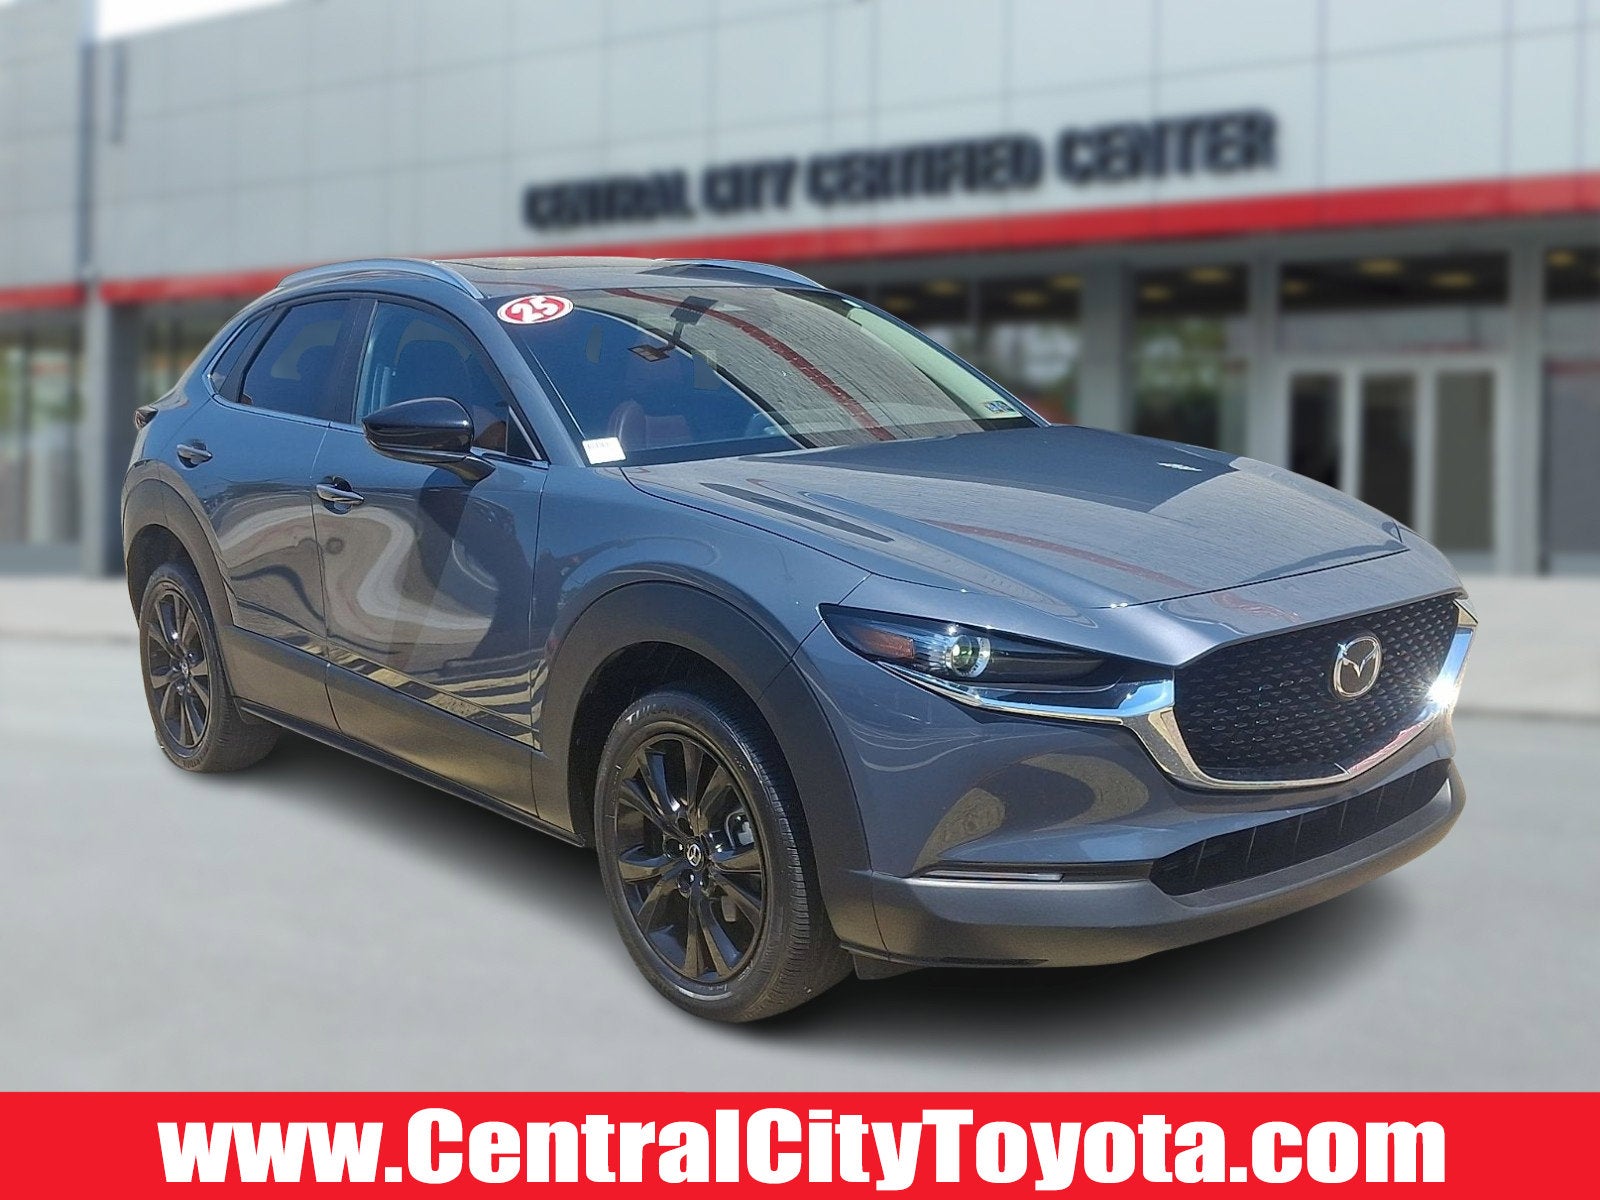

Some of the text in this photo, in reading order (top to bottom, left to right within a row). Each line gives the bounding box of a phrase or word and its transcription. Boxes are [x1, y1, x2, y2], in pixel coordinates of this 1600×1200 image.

[702, 157, 798, 216] CITY
[1055, 108, 1279, 187] CENTER
[510, 296, 560, 322] 25
